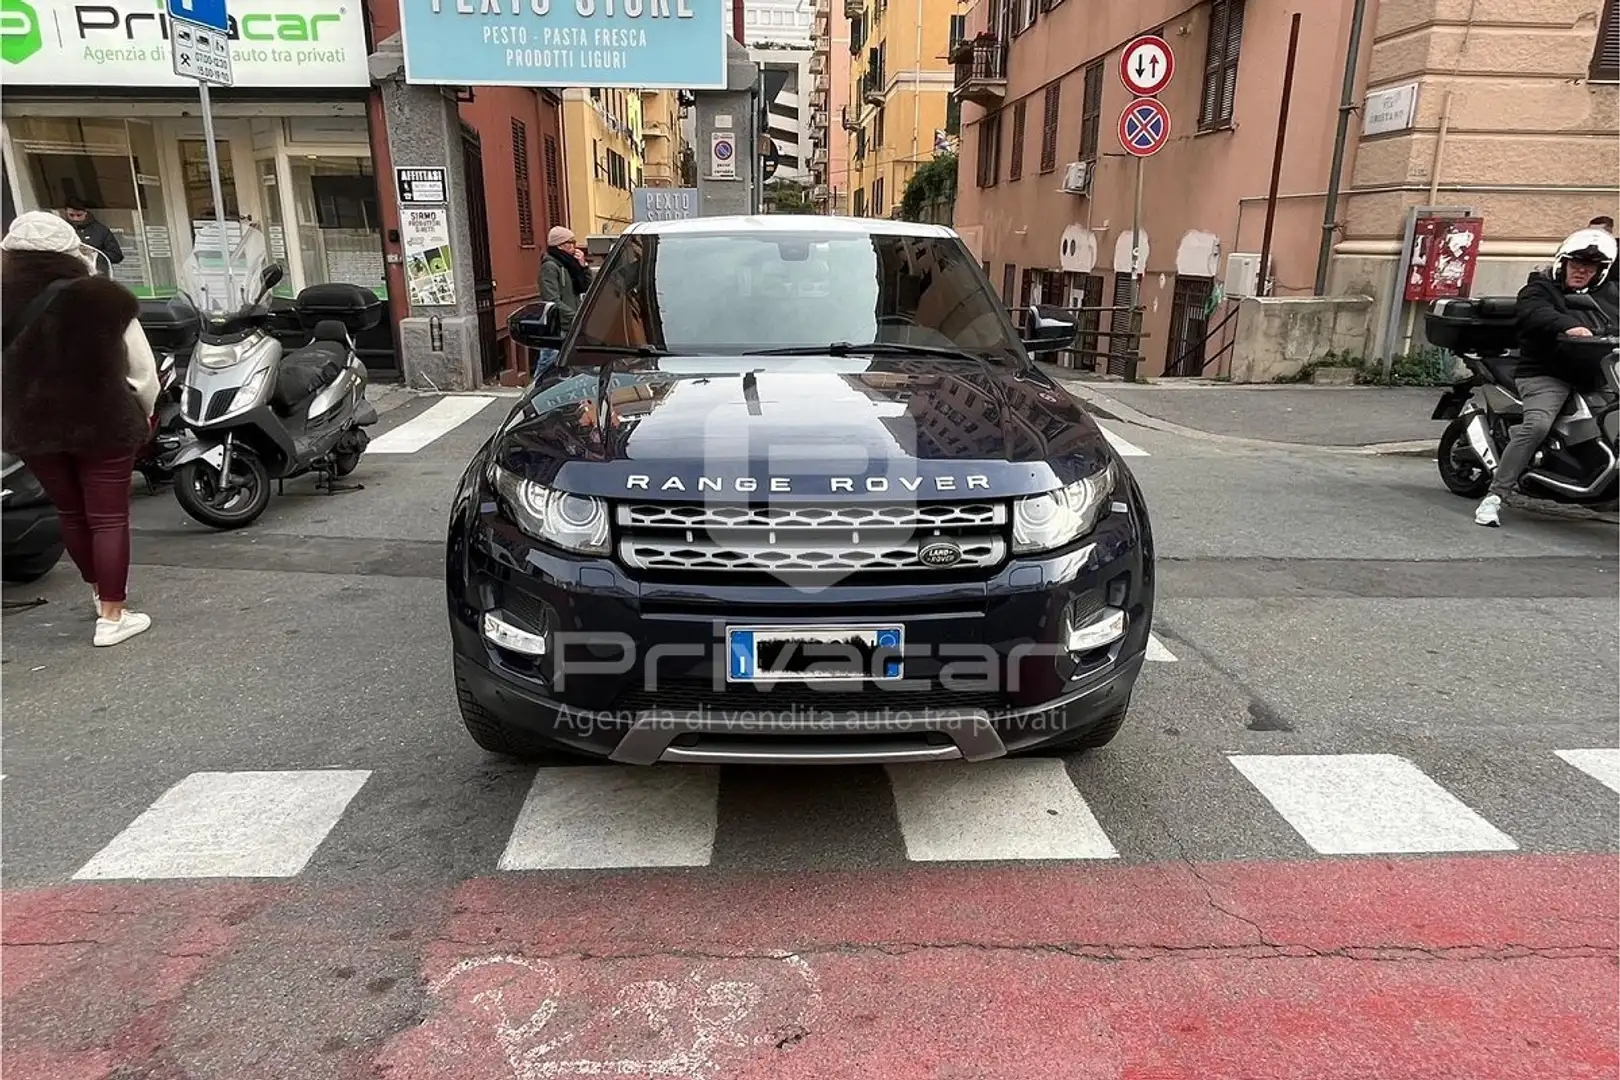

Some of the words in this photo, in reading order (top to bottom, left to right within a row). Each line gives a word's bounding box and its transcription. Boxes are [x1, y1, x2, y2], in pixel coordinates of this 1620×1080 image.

[75, 0, 340, 41] Pricar
[483, 26, 527, 45] PESTO
[543, 27, 588, 46] PASTA
[595, 28, 647, 47] FRESCA
[83, 46, 147, 65] Agenzia
[150, 46, 166, 61] di
[232, 48, 268, 62] auto
[272, 48, 293, 62] tra
[297, 47, 346, 66] privati
[506, 48, 574, 68] PRODOTTI
[580, 50, 627, 69] LIGURI
[401, 170, 443, 181] AFFITTASI
[646, 192, 690, 210] PEXTO
[410, 211, 437, 221] SIAMO
[626, 475, 792, 492] RANGE
[830, 474, 991, 492] ROVER
